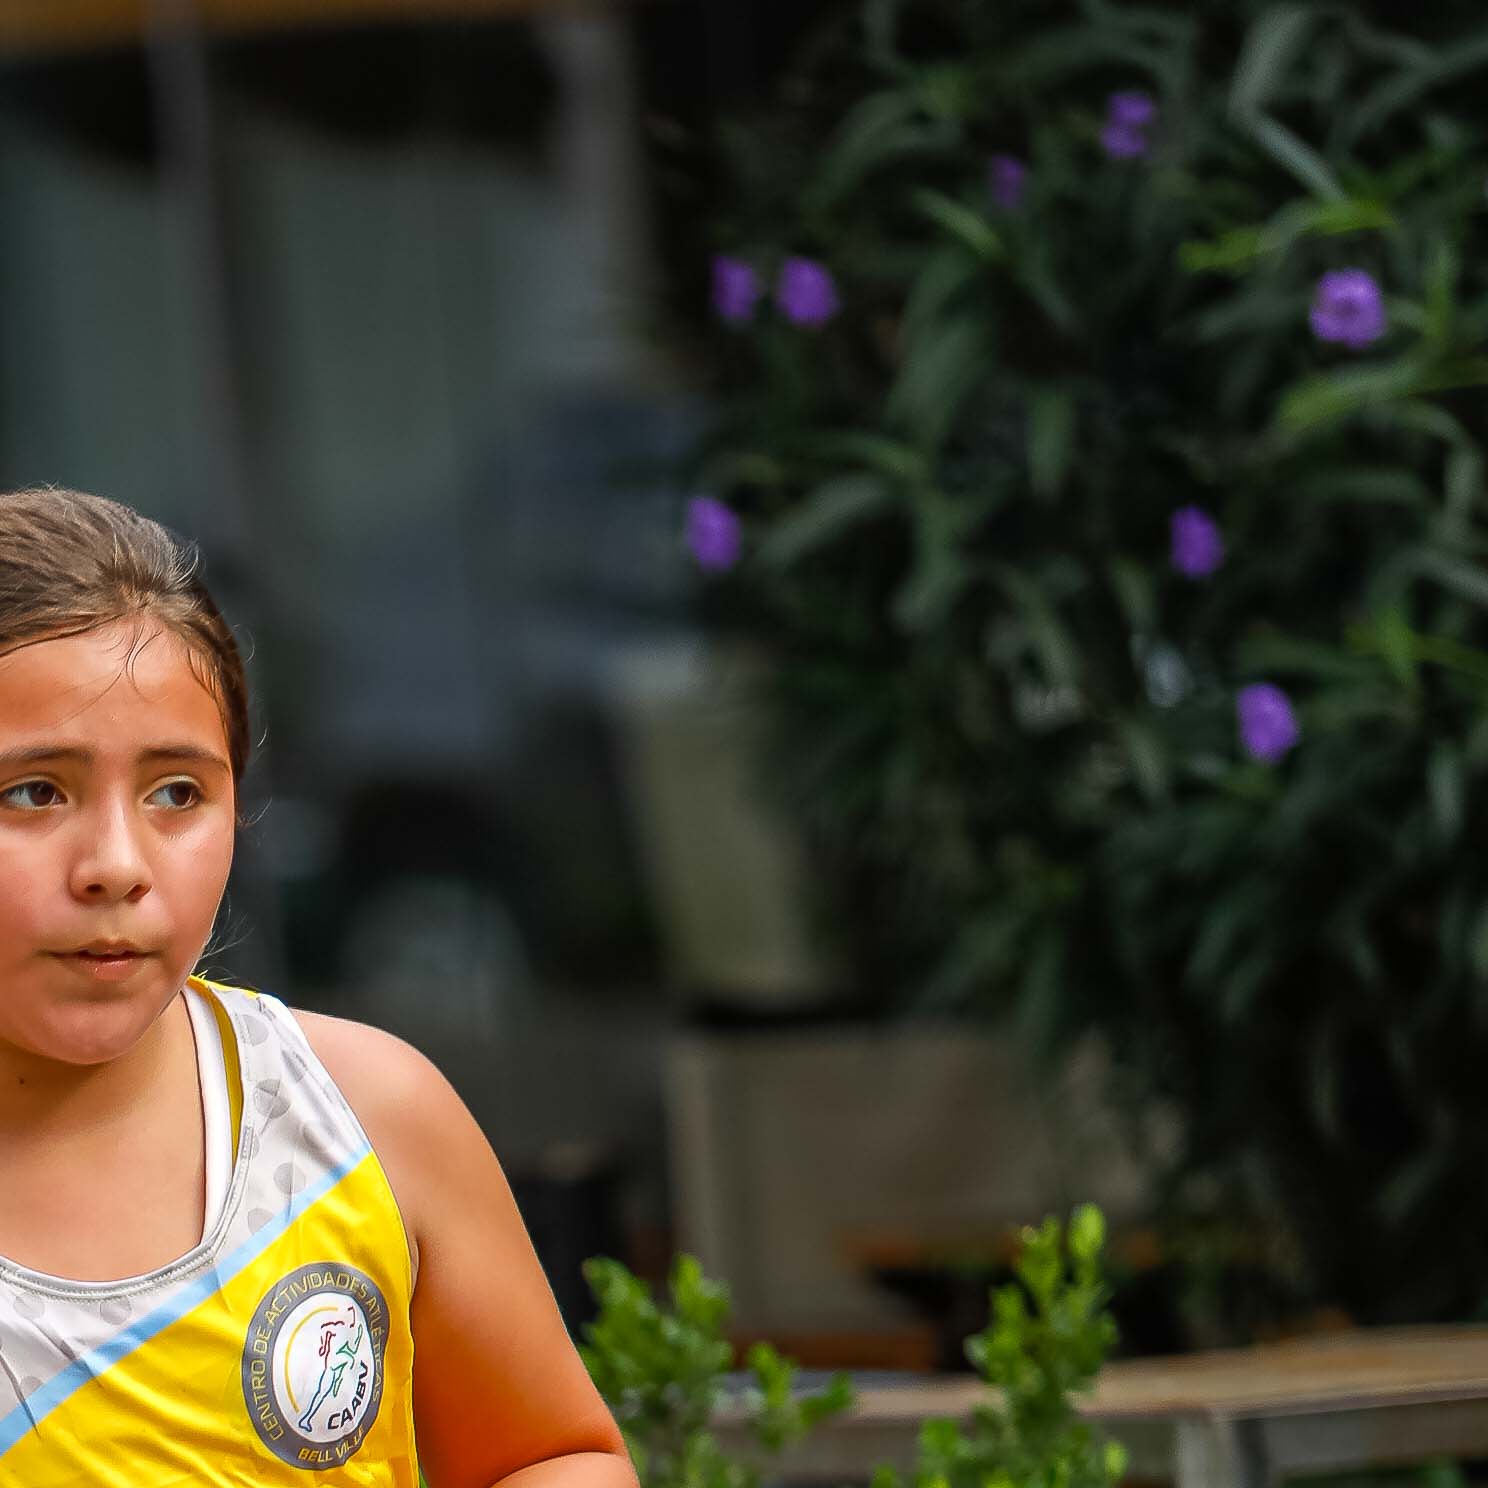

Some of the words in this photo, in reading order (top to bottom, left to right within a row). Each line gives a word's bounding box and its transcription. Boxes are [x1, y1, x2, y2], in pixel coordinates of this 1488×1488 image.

[264, 1270, 369, 1328] ACTIVIDADES
[253, 1326, 272, 1354] DE
[251, 1360, 285, 1441] CENTRO
[327, 1359, 369, 1431] CAABV
[298, 1446, 333, 1464] BELL
